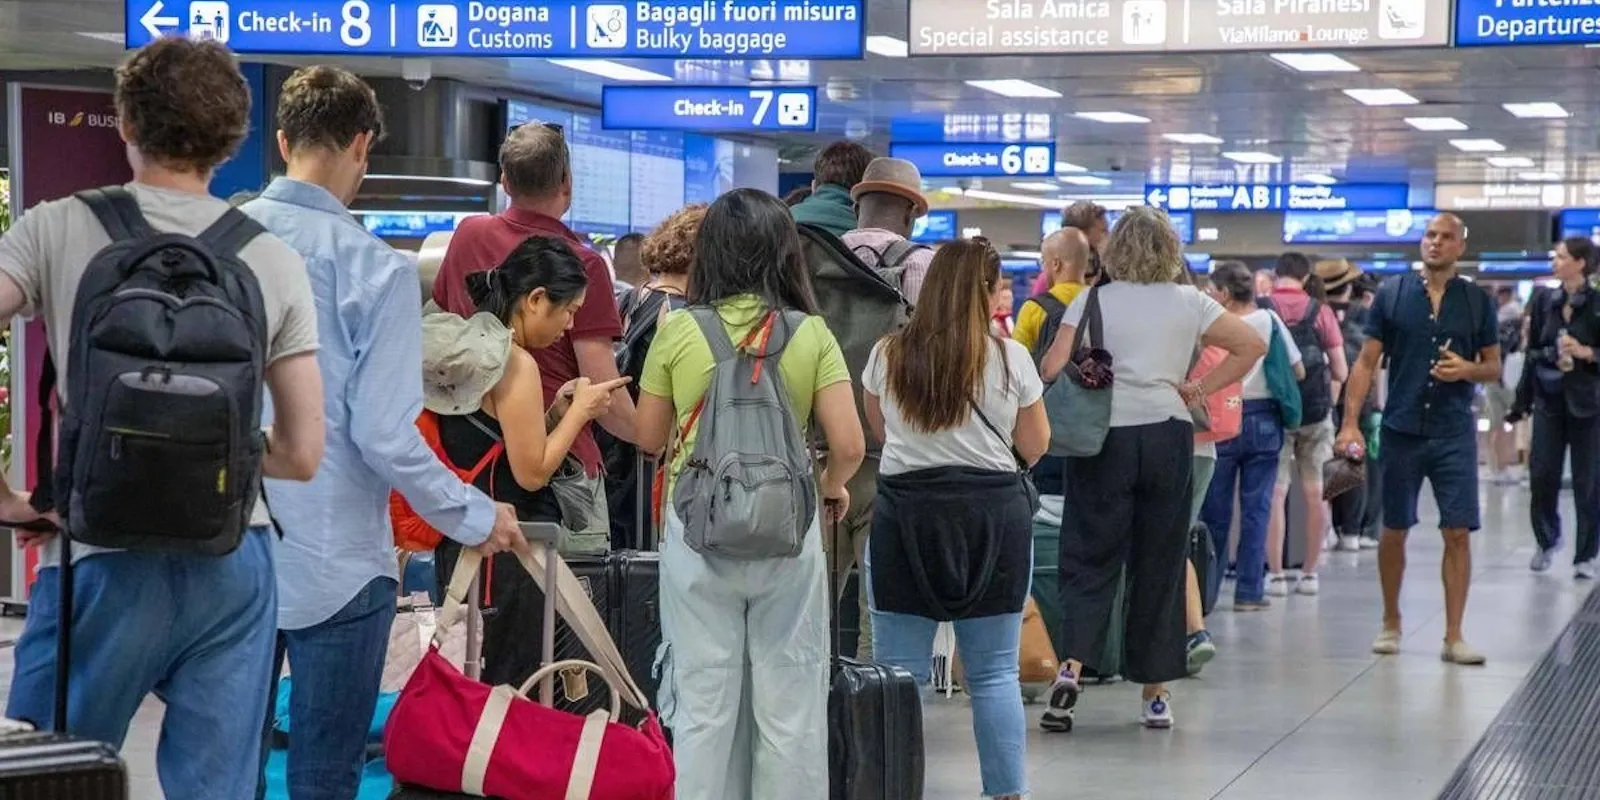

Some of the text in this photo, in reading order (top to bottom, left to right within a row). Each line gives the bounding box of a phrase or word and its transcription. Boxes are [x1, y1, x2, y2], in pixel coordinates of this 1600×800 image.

[468, 2, 549, 23] Dogana
[636, 0, 856, 27] Bagagli fuori misura
[987, 0, 1110, 19] Sala Amica
[1216, 0, 1265, 16] Sala
[237, 0, 372, 46] Check-in 8
[1219, 25, 1369, 44] ViaMilano Lounge
[468, 27, 553, 49] Customs
[636, 28, 786, 54] Bulky baggage
[919, 26, 1109, 50] Special assistance
[674, 90, 774, 126] Check-in 7
[88, 113, 120, 128] BUSI
[1001, 145, 1022, 175] 6
